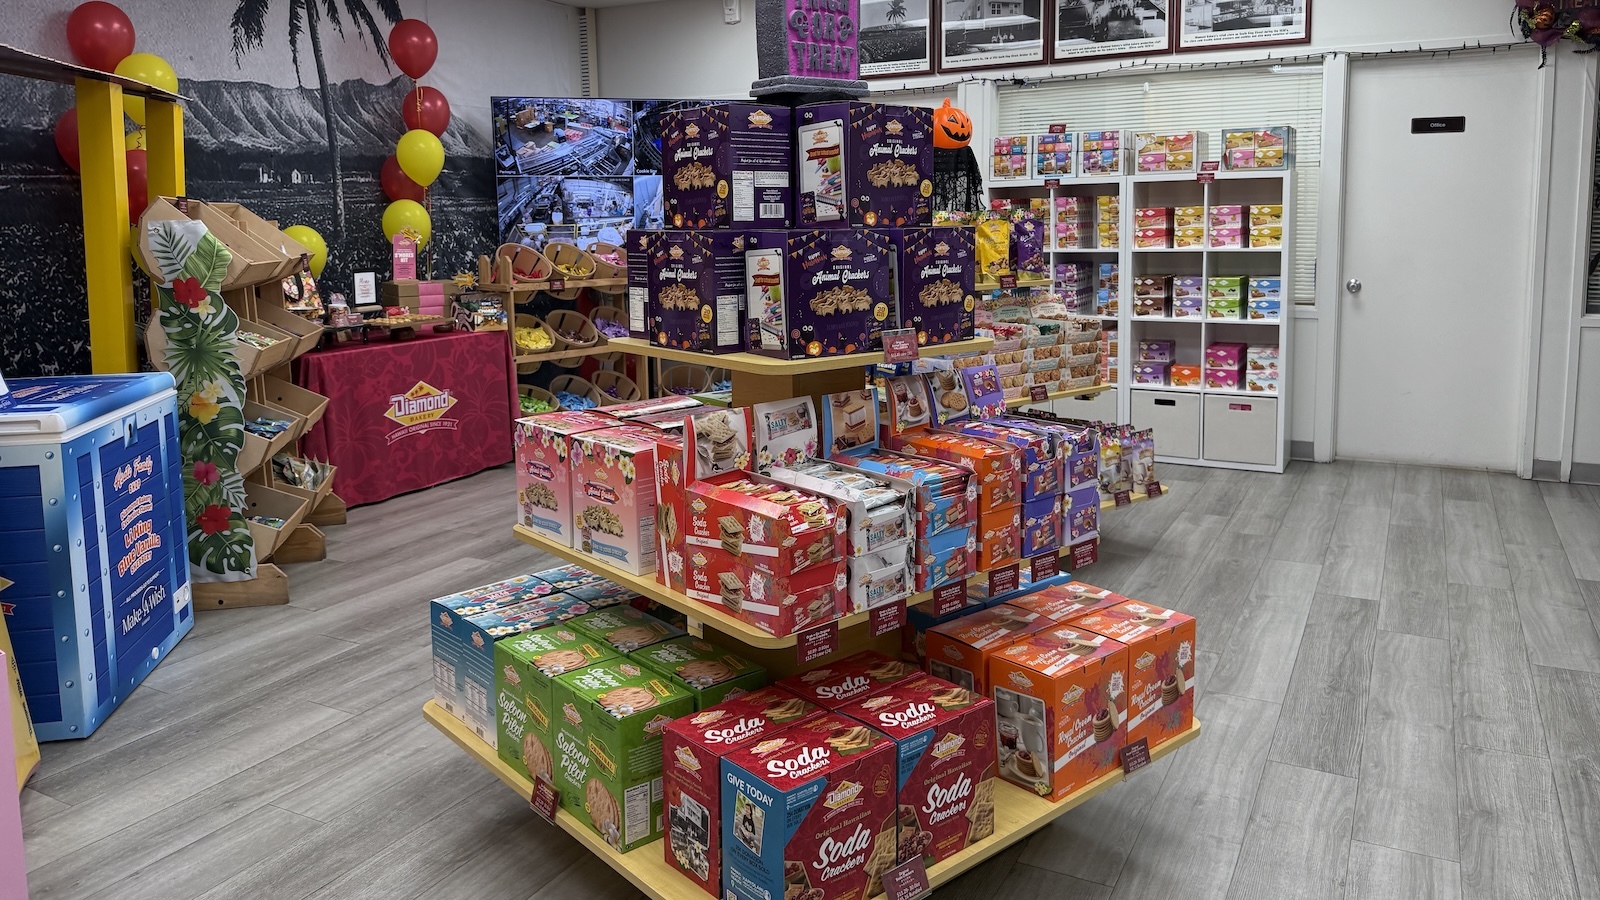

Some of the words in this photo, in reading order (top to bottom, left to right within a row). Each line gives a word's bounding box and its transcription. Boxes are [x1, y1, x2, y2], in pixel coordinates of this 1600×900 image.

[812, 11, 835, 41] OR
[792, 40, 854, 73] TREAT
[869, 143, 893, 157] Animal
[894, 143, 918, 158] Crackers
[812, 270, 840, 285] Animal
[842, 269, 870, 284] Crackers
[921, 264, 941, 279] Animal
[942, 264, 962, 278] Crackers
[389, 389, 450, 417] Diamond
[410, 413, 435, 422] BAKERY
[771, 418, 787, 428] SALTY
[409, 424, 429, 432] ORIGINAL
[692, 516, 707, 527] Soda
[124, 532, 133, 549] Li
[133, 519, 152, 538] Hing
[870, 530, 884, 541] SALTY
[117, 549, 136, 578] Blue
[135, 533, 161, 559] Vanilla
[693, 570, 708, 582] Soda
[870, 585, 884, 597] SALTY
[1102, 624, 1117, 635] Royal
[516, 639, 544, 652] Pilot
[527, 634, 556, 650] Saloon
[651, 649, 684, 663] Pilot
[662, 644, 696, 660] Saloon
[1026, 653, 1043, 667] Royal
[1055, 657, 1070, 668] Original
[575, 674, 608, 689] Pilot
[588, 668, 621, 686] Saloon
[816, 675, 870, 699] Soda
[836, 685, 870, 700] Crackers
[1131, 686, 1146, 706] Royal
[498, 692, 528, 724] Saloon
[1139, 693, 1156, 710] Cracker
[528, 701, 547, 724] ORIGINAL
[878, 702, 935, 726] Soda
[901, 712, 936, 729] Crackers
[1140, 704, 1156, 720] Original
[502, 712, 524, 739] Pilot
[704, 717, 765, 743] Soda
[1058, 721, 1075, 744] Royal
[505, 728, 520, 743] Crackers
[725, 726, 764, 744] Crackers
[1067, 730, 1086, 747] Cracker
[556, 732, 590, 768] Saloon
[934, 736, 962, 754] Diamond
[1068, 740, 1086, 758] Original
[590, 743, 613, 771] ORIGINAL
[767, 746, 830, 777] Soda
[560, 754, 587, 784] Pilot
[789, 759, 830, 779] Crackers
[924, 771, 946, 786] Original
[948, 760, 972, 774] Hawaiian
[564, 772, 582, 790] Crackers
[727, 773, 744, 791] GIVE
[746, 784, 773, 807] TODAY
[827, 783, 860, 805] Diamond
[922, 772, 972, 814] Soda
[929, 800, 967, 826] Crackers
[815, 823, 842, 839] Original
[843, 810, 871, 827] Hawaiian
[812, 823, 872, 869] Soda
[821, 853, 865, 881] Crackers
